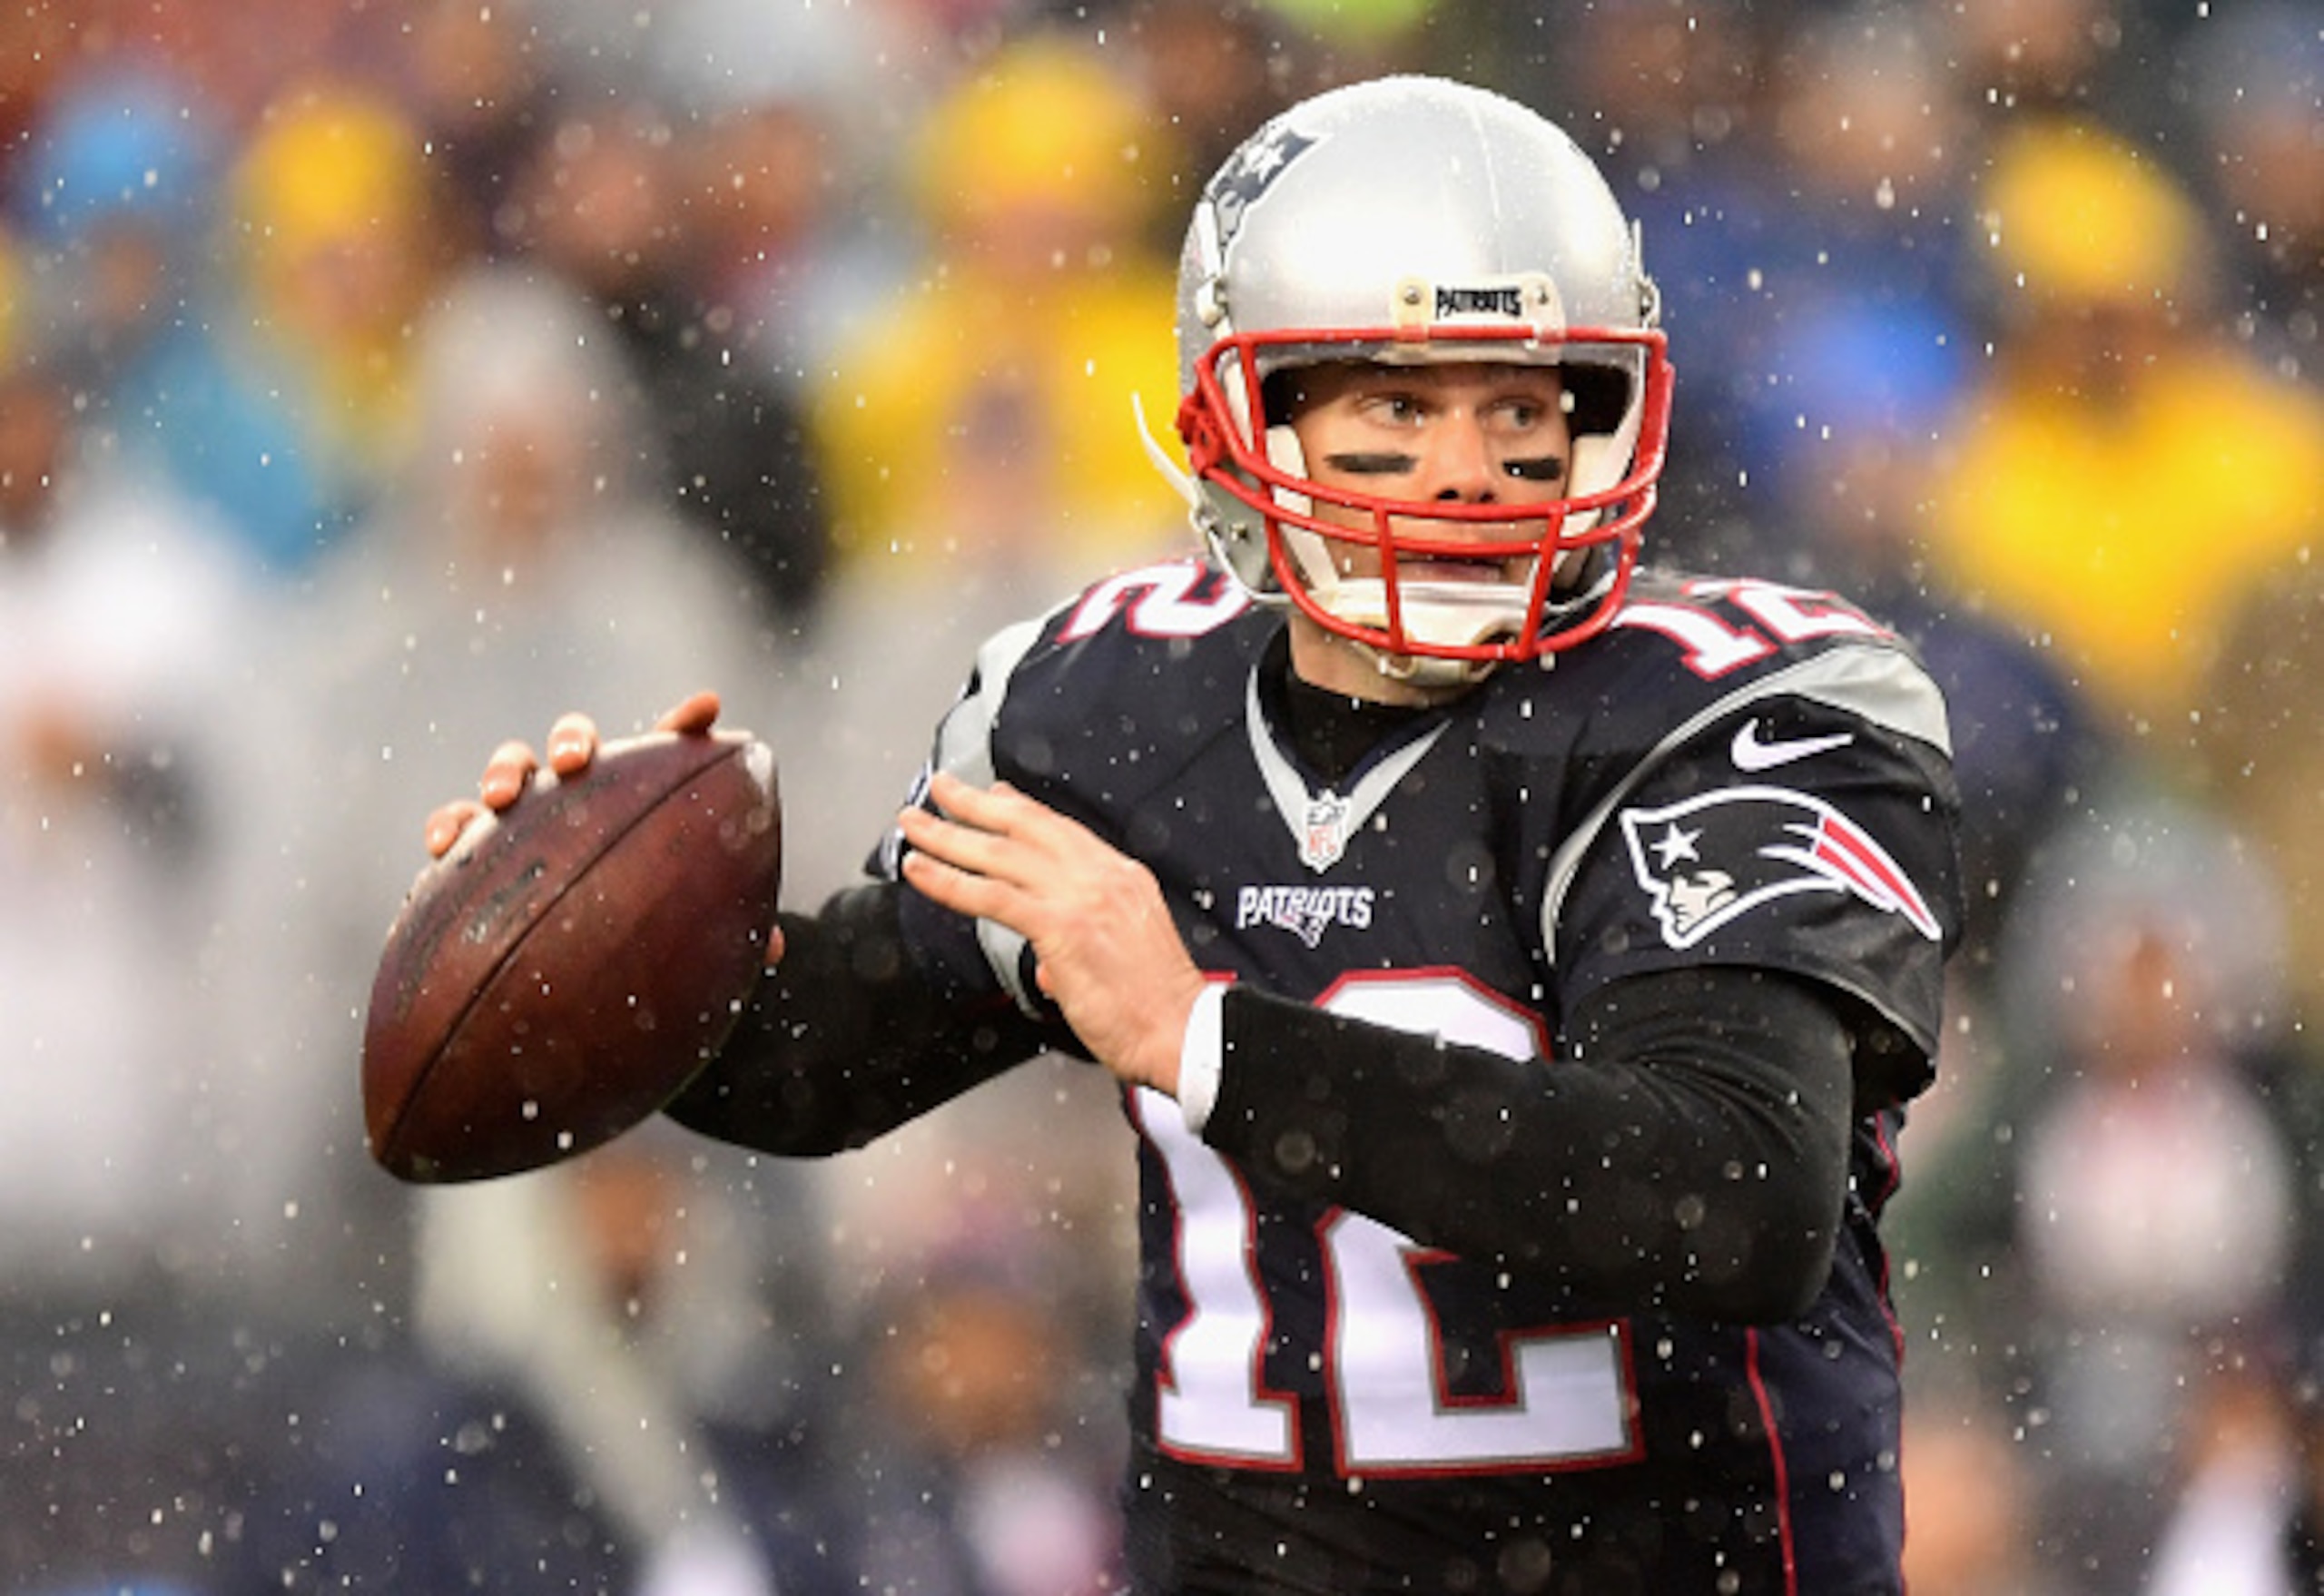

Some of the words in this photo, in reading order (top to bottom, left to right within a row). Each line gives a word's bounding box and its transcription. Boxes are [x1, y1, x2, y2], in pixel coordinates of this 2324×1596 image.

[1435, 286, 1522, 319] PATRIOTS
[1609, 577, 1896, 682] 12
[1235, 884, 1375, 930] PATRIOTS
